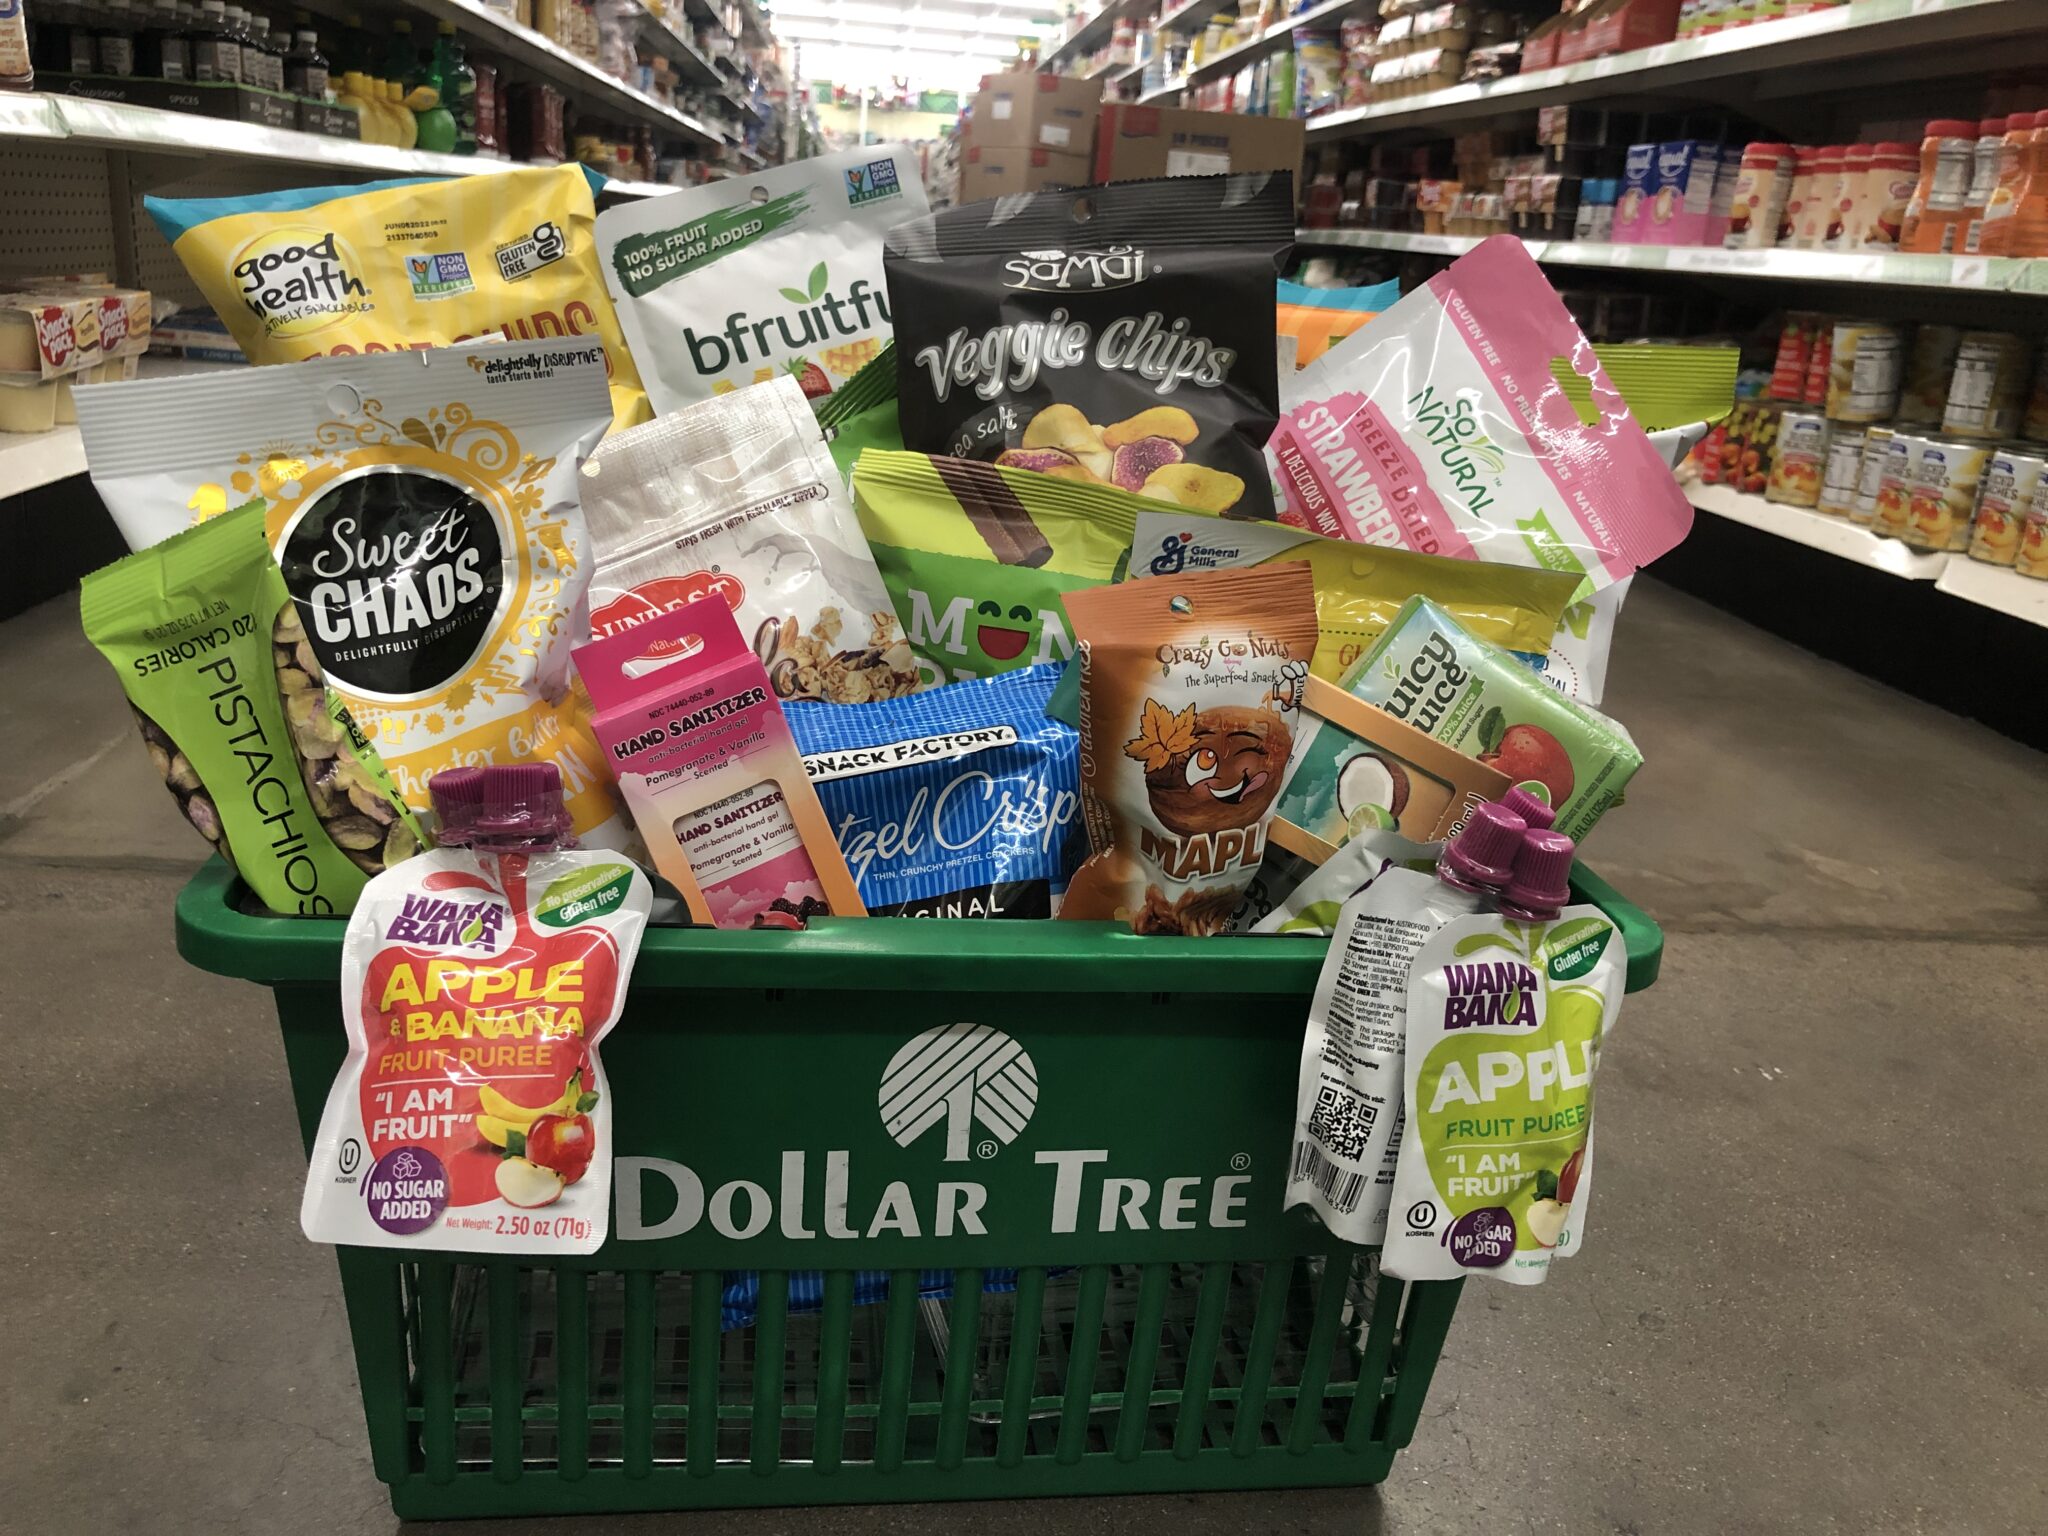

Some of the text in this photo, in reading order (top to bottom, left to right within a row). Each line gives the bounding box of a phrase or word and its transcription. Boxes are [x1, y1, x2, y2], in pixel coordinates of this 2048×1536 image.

[870, 160, 893, 172] NON
[872, 169, 895, 180] GMO
[438, 255, 463, 264] NON
[500, 242, 536, 264] GLUTEN
[623, 222, 709, 267] 100% FRUIT
[629, 219, 763, 283] NO SUGAR ADDED
[234, 233, 340, 293] good
[440, 263, 466, 273] GMO
[503, 260, 527, 277] FREE
[246, 262, 366, 322] health
[416, 279, 471, 293] VERIFIED
[485, 354, 542, 374] delightfully
[915, 308, 1237, 402] Veggie Chips
[487, 368, 554, 384] taste starts here!
[977, 406, 1018, 441] salt
[1445, 399, 1476, 437] SO
[1452, 298, 1482, 340] GLUTEN
[1478, 340, 1501, 367] FREE
[1501, 375, 1517, 395] NO
[1573, 490, 1610, 547] NATURAL
[1408, 386, 1494, 518] NATURAL
[1281, 447, 1340, 534] A DELICIOUS WAY
[1298, 406, 1410, 550] STRAWBER
[1355, 406, 1440, 554] FREEZE DRIED
[675, 486, 819, 550] STAYS FRESH WITH RESEALABLE ZIPPER
[312, 508, 469, 578] Sweet
[1190, 545, 1240, 559] General
[1188, 556, 1217, 568] Mills
[212, 598, 230, 615] NET
[311, 547, 484, 643] CHAOS
[134, 628, 231, 677] CALORIES
[335, 638, 420, 662] DELIGHTFULLY
[1155, 635, 1291, 670] Crazy Nuts
[1185, 669, 1278, 688] The Superfood Snack
[1375, 631, 1457, 719] uicy
[649, 688, 715, 720] NDC 74440-052-89
[1406, 661, 1468, 734] uice
[1456, 692, 1477, 719] Juice
[508, 712, 561, 758] Butter
[613, 687, 768, 761] HAND SANITIZER
[648, 716, 750, 764] anti-bacterial hand gel
[1456, 703, 1485, 744] Added Sugar
[645, 731, 766, 787] Pomegranate & Vanilla
[693, 760, 729, 780] Scented
[804, 728, 1005, 777] SNACK FACTORY
[197, 656, 334, 915] PISTACHIOS
[676, 791, 784, 845] HAND SANITIZER
[694, 808, 709, 820] NDC
[837, 786, 929, 891] tzel
[933, 770, 1082, 853] Crisp
[690, 822, 795, 873] Pomegranate & Vanilla
[693, 811, 779, 854] anti-bacterial hand gel
[732, 849, 763, 868] Scented
[901, 847, 1035, 877] CRUNCHY PRETZEL CRACKERS
[1140, 819, 1271, 884] MAPL
[545, 866, 622, 907] No preservatives
[559, 885, 620, 922] Gluten free
[401, 894, 504, 931] WANA
[1396, 920, 1430, 932] AUSTROFOOD
[385, 916, 496, 952] BANA
[1402, 937, 1425, 947] Ecuador
[1552, 920, 1603, 955] preservatives
[1553, 940, 1600, 973] Gluten free
[380, 960, 584, 1013] APPLE
[1443, 962, 1538, 996] WANA
[390, 1007, 584, 1042] & BANANA
[1444, 992, 1538, 1030] BANA
[1354, 1039, 1375, 1050] opened
[1372, 1029, 1395, 1038] package
[379, 1045, 552, 1075] FRUIT PUREE
[1348, 1053, 1379, 1070] Packaging
[402, 1088, 453, 1112] AM
[1321, 1072, 1370, 1101] For more products
[1446, 1104, 1586, 1139] FRUIT PUREE
[335, 1176, 357, 1184] KOSHER
[1476, 1152, 1520, 1173] AM
[372, 1179, 444, 1200] NO SUGAR
[380, 1201, 431, 1220] ADDED
[446, 1216, 592, 1239] Net Weight: 2.50 oz (71g)
[1454, 1234, 1473, 1250] NO
